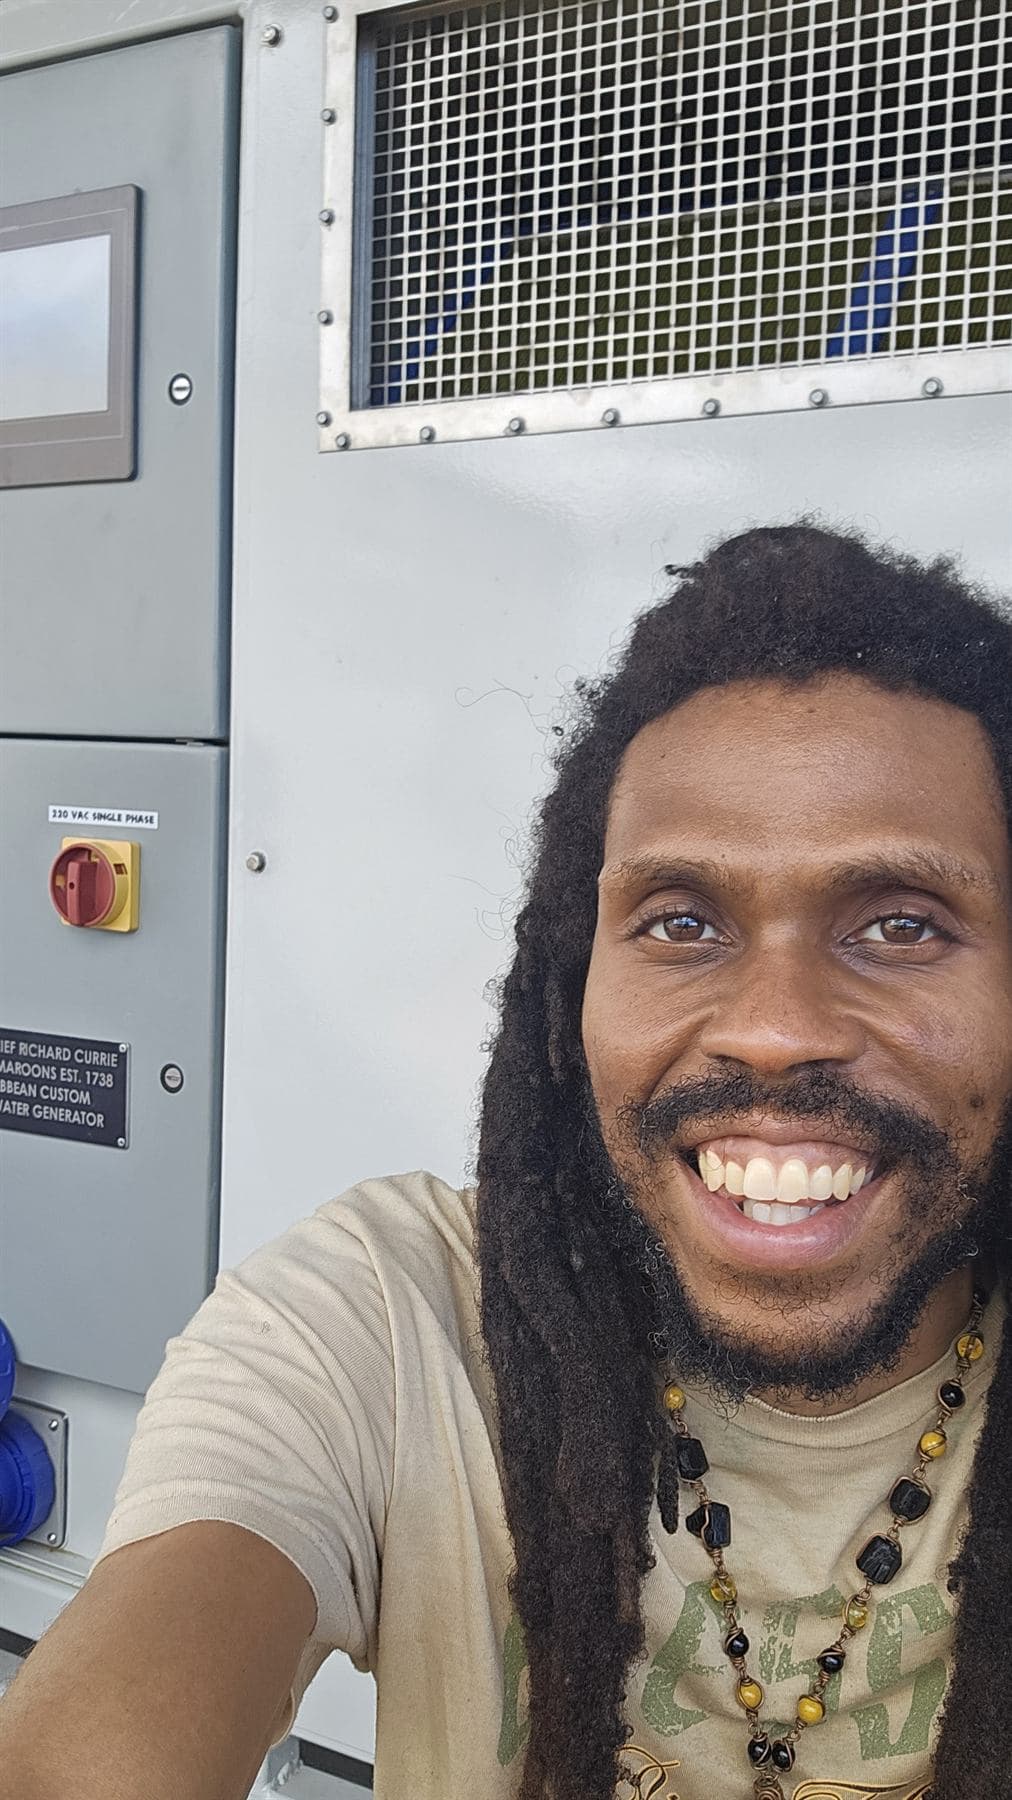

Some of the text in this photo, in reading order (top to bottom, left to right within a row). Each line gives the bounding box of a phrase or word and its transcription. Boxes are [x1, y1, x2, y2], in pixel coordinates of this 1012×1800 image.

[71, 811, 88, 820] VAC
[92, 813, 122, 822] SINGLE
[125, 814, 154, 824] PHASE
[19, 1042, 71, 1061] RICHARD
[74, 1049, 118, 1067] CURRIE
[60, 1068, 81, 1083] EST.
[85, 1071, 113, 1088] 1738
[40, 1085, 91, 1105] CUSTOM
[0, 1100, 104, 1128] ATER GENERATOR
